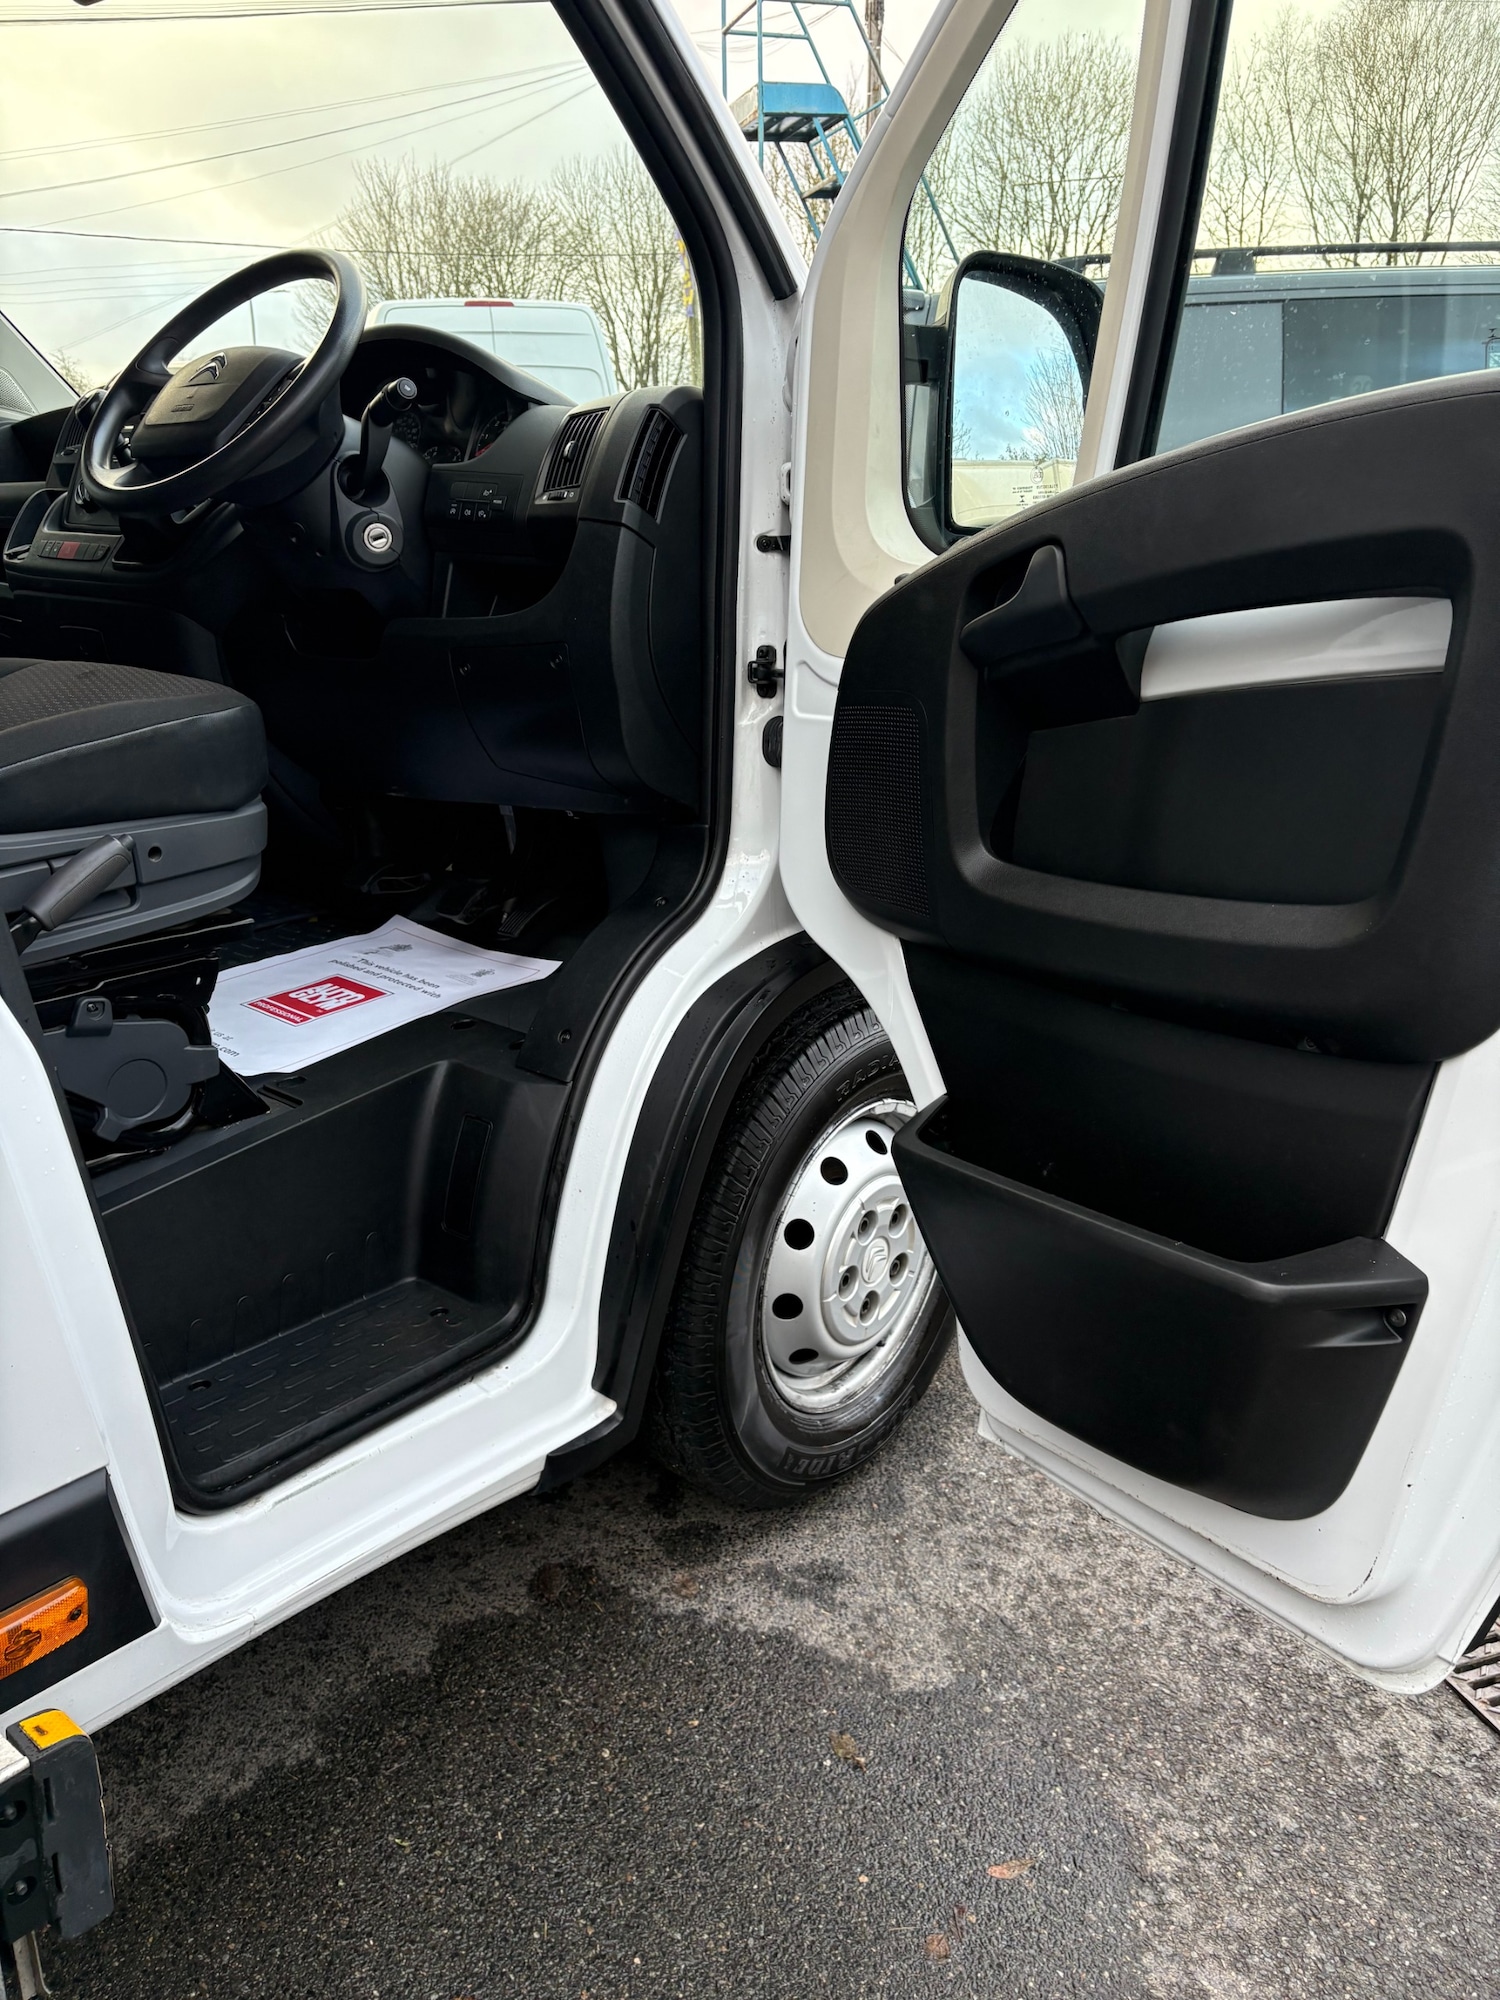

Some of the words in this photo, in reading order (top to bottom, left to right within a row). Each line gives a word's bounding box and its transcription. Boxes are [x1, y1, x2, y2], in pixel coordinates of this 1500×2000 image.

[328, 958, 366, 972] polished
[362, 968, 381, 978] and
[376, 973, 422, 992] protected
[421, 987, 442, 1000] with
[357, 957, 373, 967] This
[375, 963, 403, 976] vehicle
[404, 972, 419, 982] has
[418, 977, 440, 990] been
[313, 982, 365, 1005] AUTO
[253, 1001, 303, 1023] PROFESSIONAL
[835, 1053, 900, 1103] RADIA
